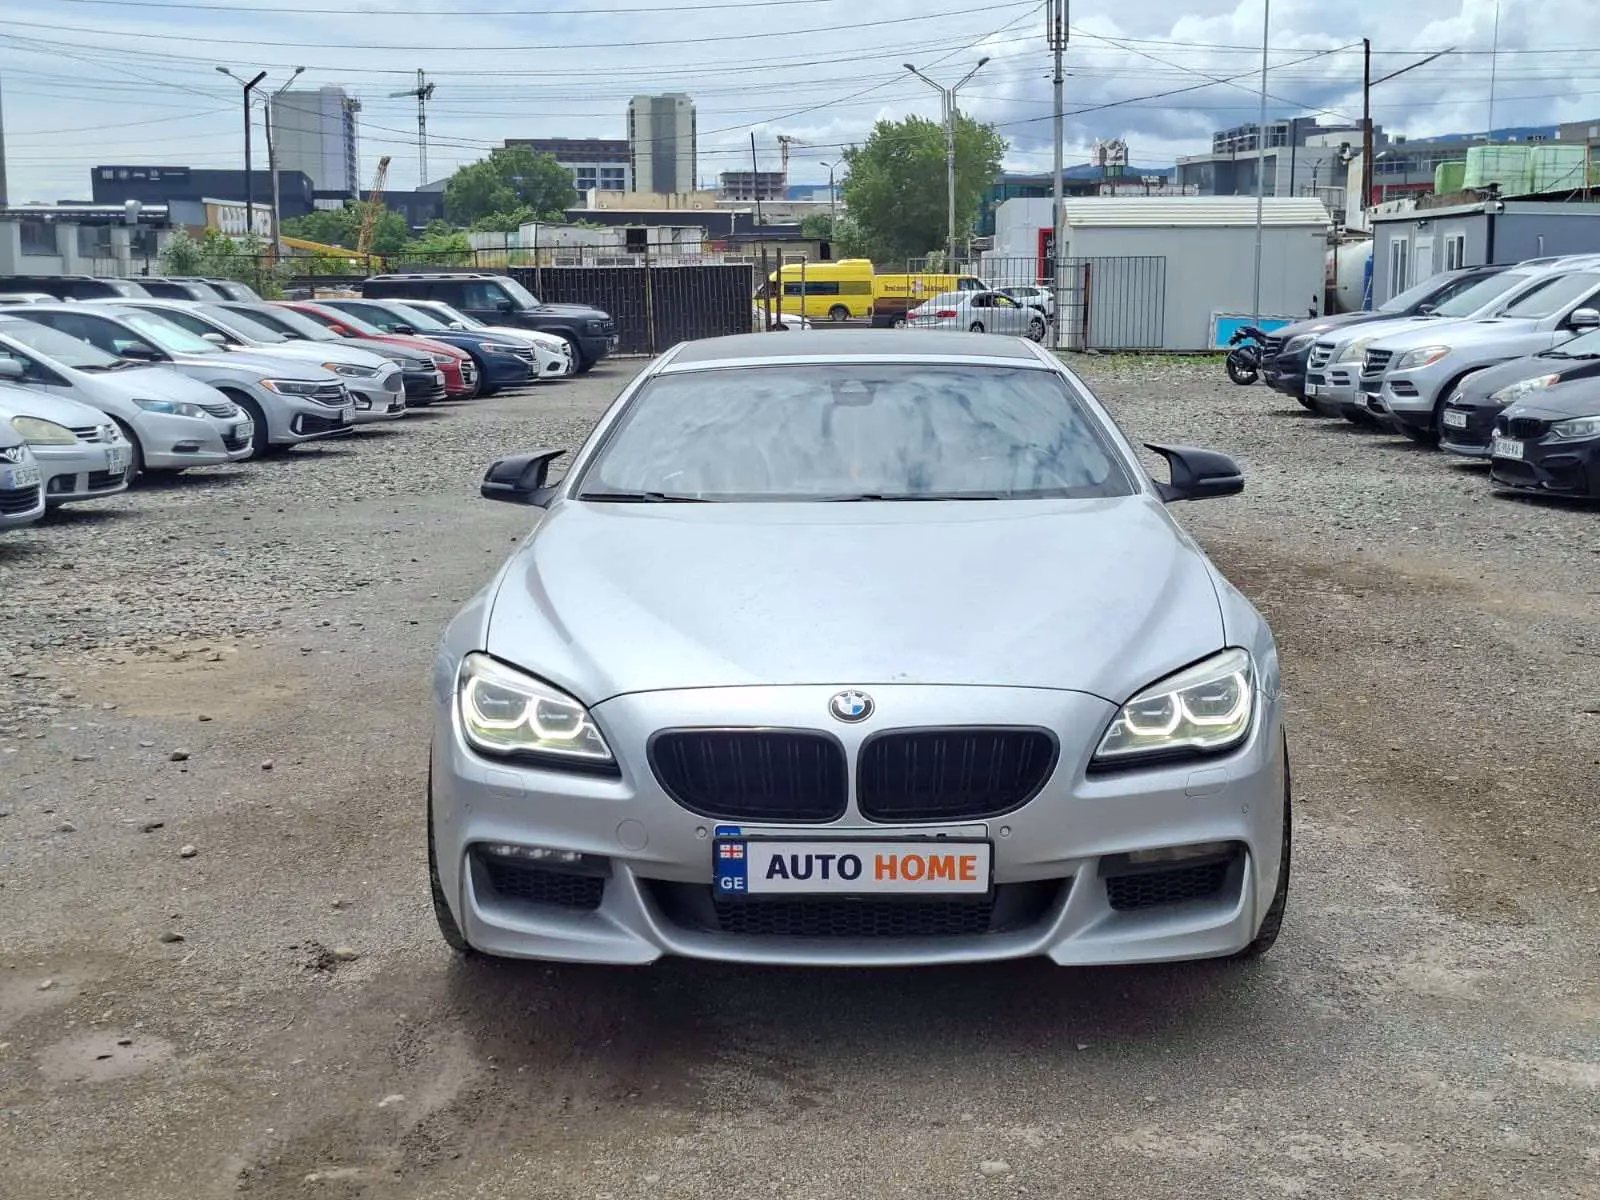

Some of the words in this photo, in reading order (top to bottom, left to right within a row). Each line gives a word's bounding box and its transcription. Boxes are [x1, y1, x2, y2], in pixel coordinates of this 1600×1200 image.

[766, 854, 862, 881] AUTO
[875, 855, 977, 881] HOME
[721, 876, 744, 890] GE
